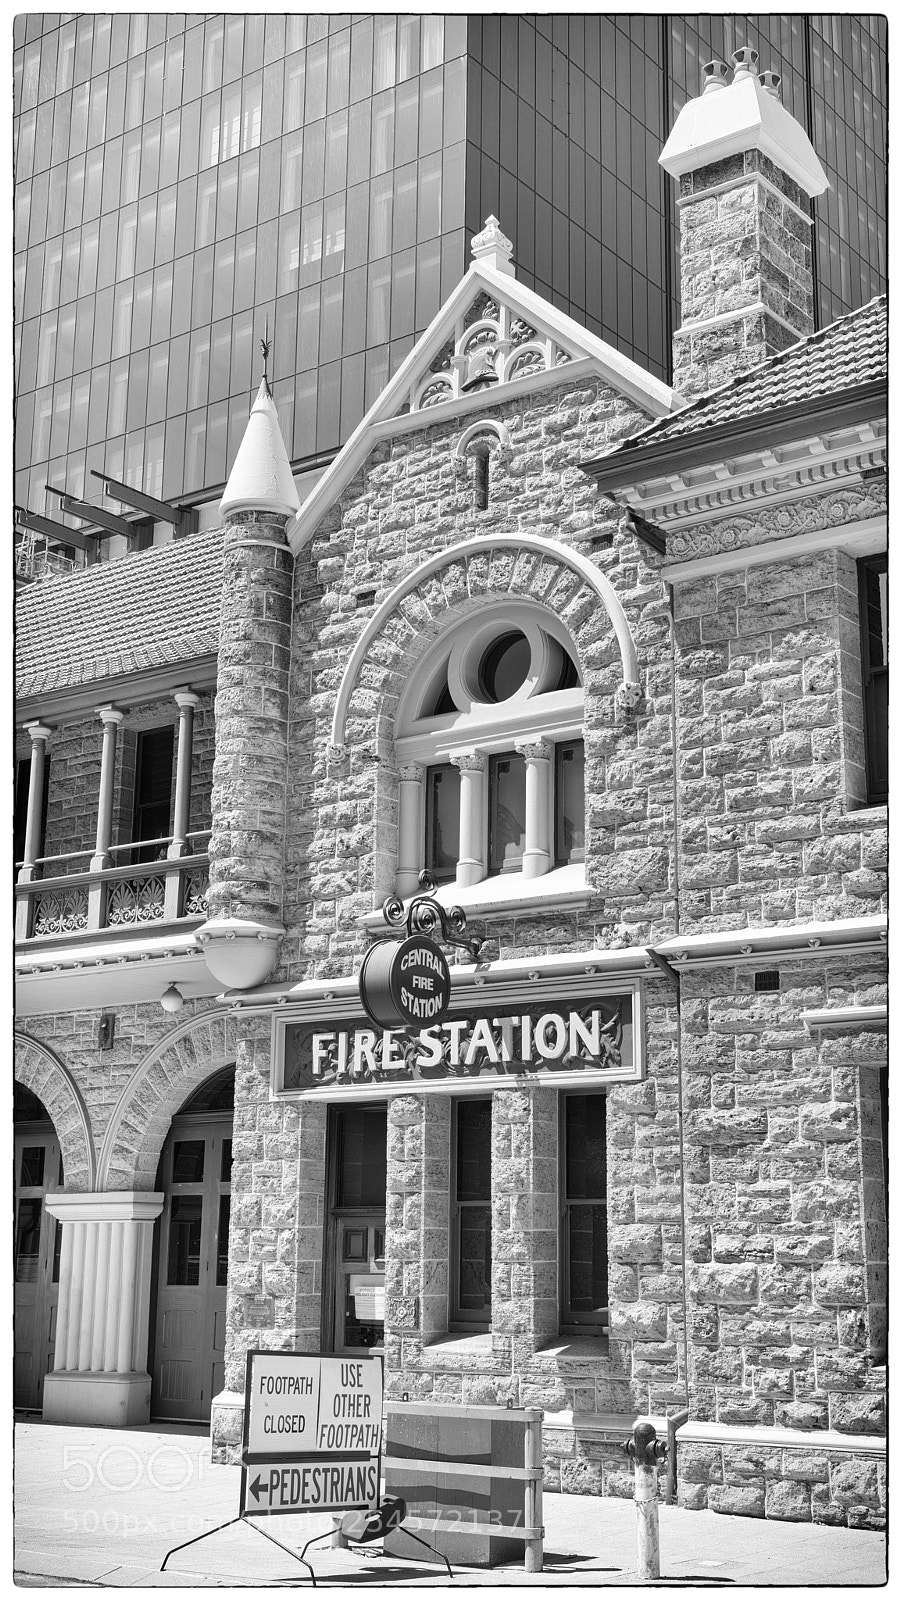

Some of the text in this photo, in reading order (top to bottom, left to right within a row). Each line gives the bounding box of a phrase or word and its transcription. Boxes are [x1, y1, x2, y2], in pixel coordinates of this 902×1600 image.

[401, 949, 445, 980] CENTRAL
[412, 975, 434, 991] FIRE
[401, 986, 443, 1018] STATION
[311, 1010, 601, 1075] FIRE STATION
[259, 1376, 313, 1395] FOOTPATH
[340, 1363, 363, 1387] USE
[333, 1394, 371, 1418] OTHER
[263, 1415, 306, 1433] CLOSED
[319, 1424, 379, 1449] FOOTPATH
[268, 1465, 377, 1506] PEDESTRIANS
